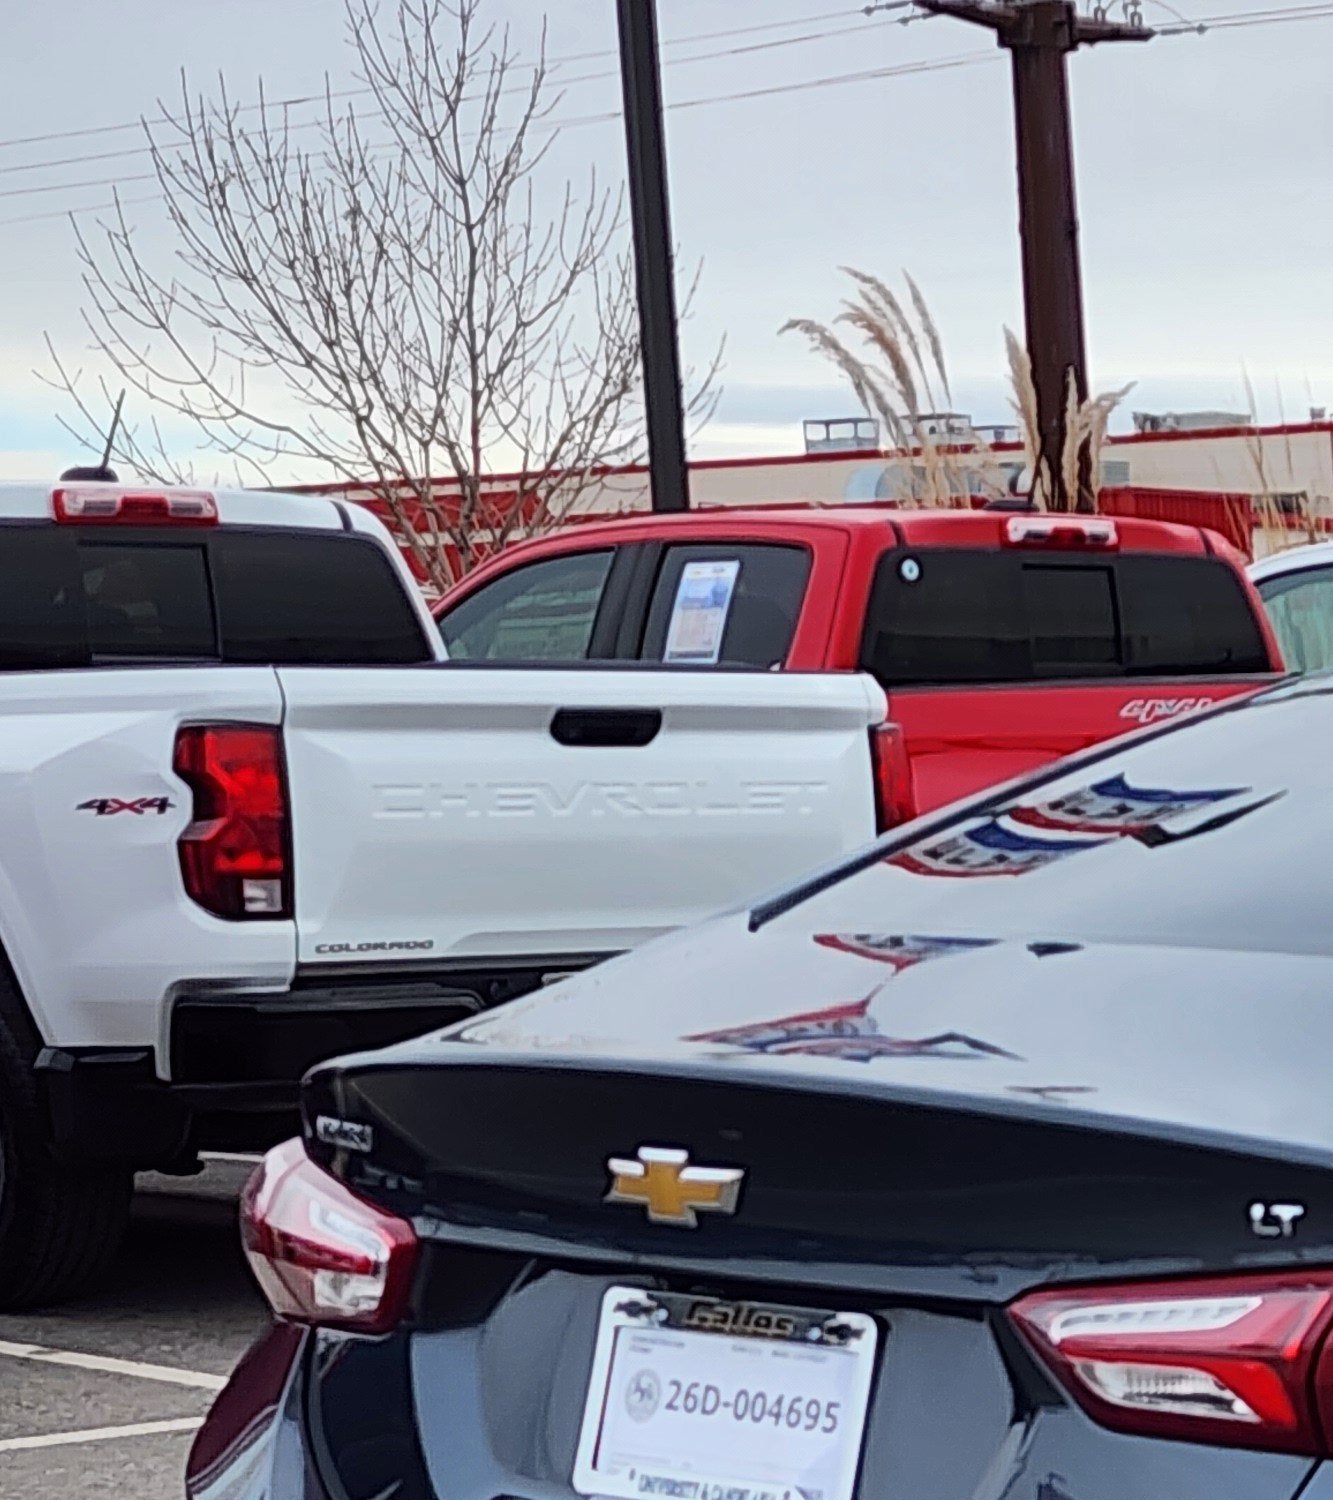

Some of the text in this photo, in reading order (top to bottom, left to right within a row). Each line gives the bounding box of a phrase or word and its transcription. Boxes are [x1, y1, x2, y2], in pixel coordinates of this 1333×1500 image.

[371, 778, 830, 820] CHEVROLET
[314, 938, 435, 955] COLORADO
[1248, 1202, 1305, 1238] LT
[664, 1379, 841, 1434] 26D-004695
